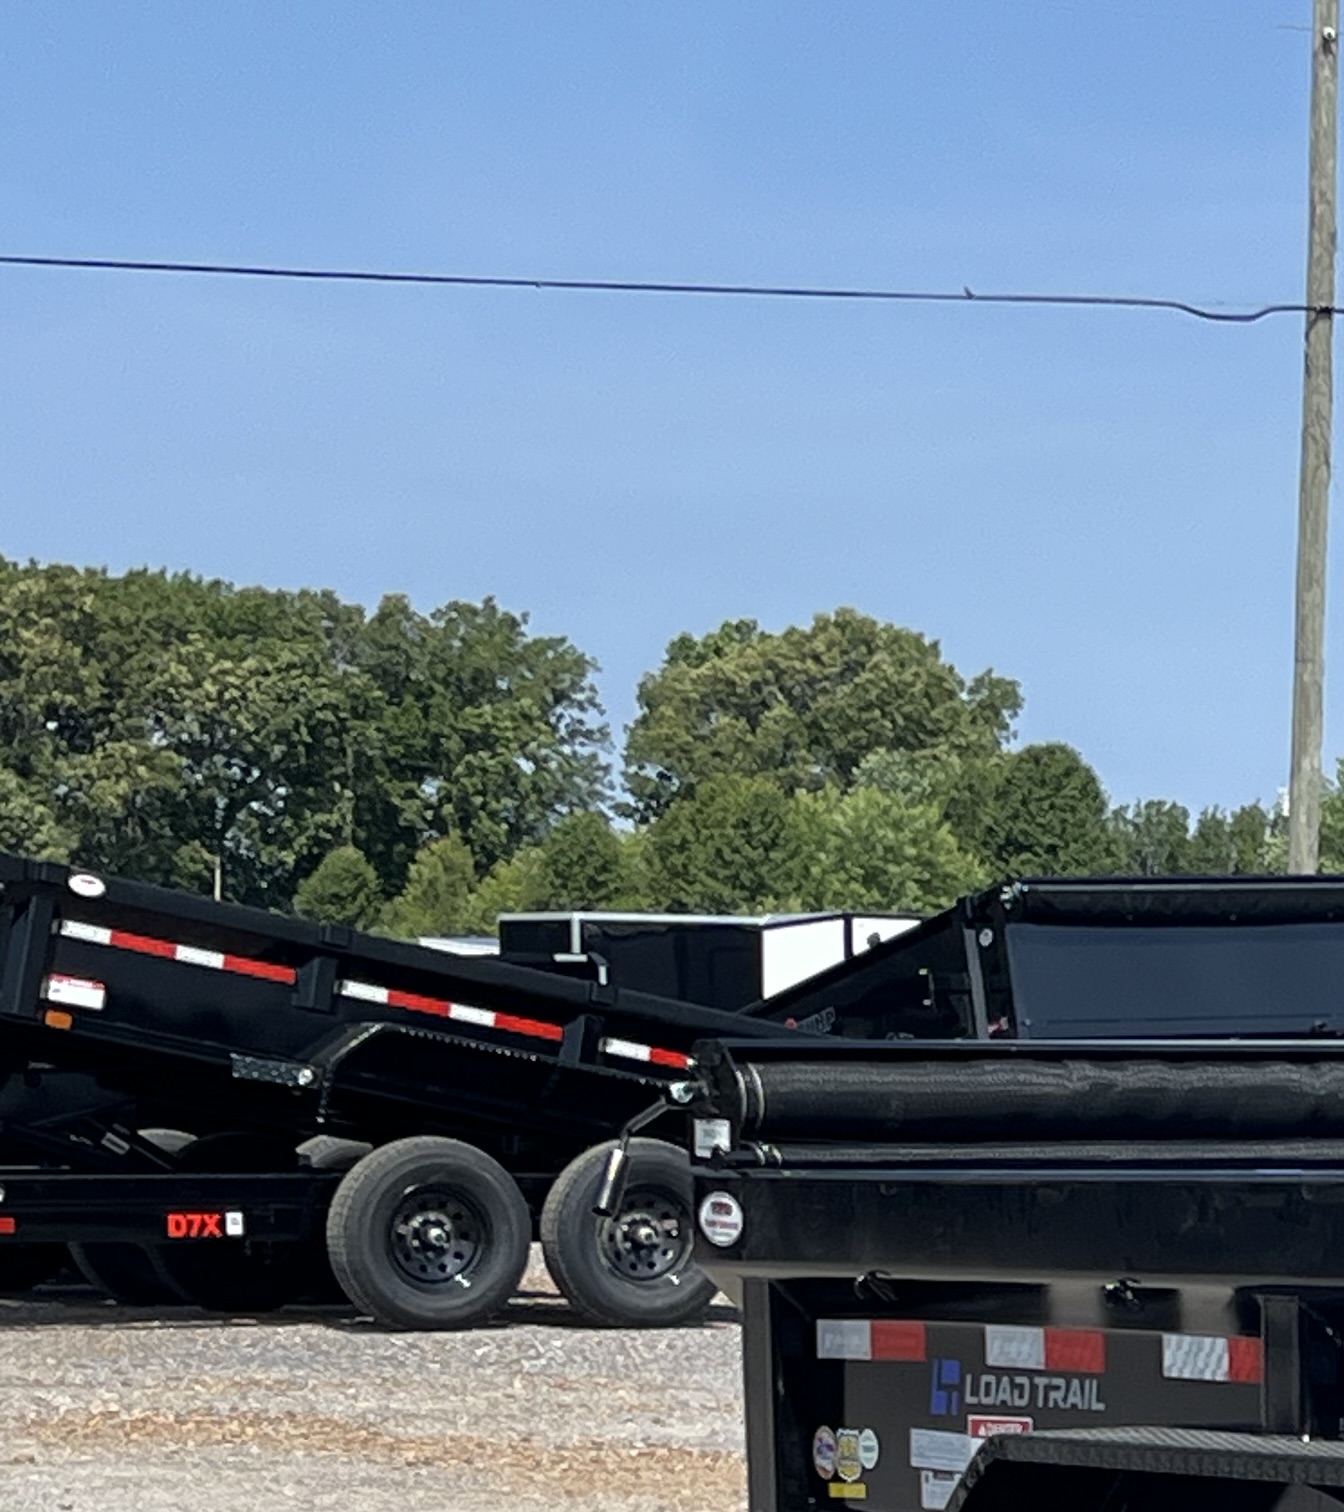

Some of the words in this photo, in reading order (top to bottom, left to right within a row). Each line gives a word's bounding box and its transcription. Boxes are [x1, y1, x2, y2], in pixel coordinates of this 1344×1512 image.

[167, 1212, 223, 1239] D7X
[964, 1373, 1031, 1407] LOAD
[1034, 1376, 1106, 1411] TRAIL
